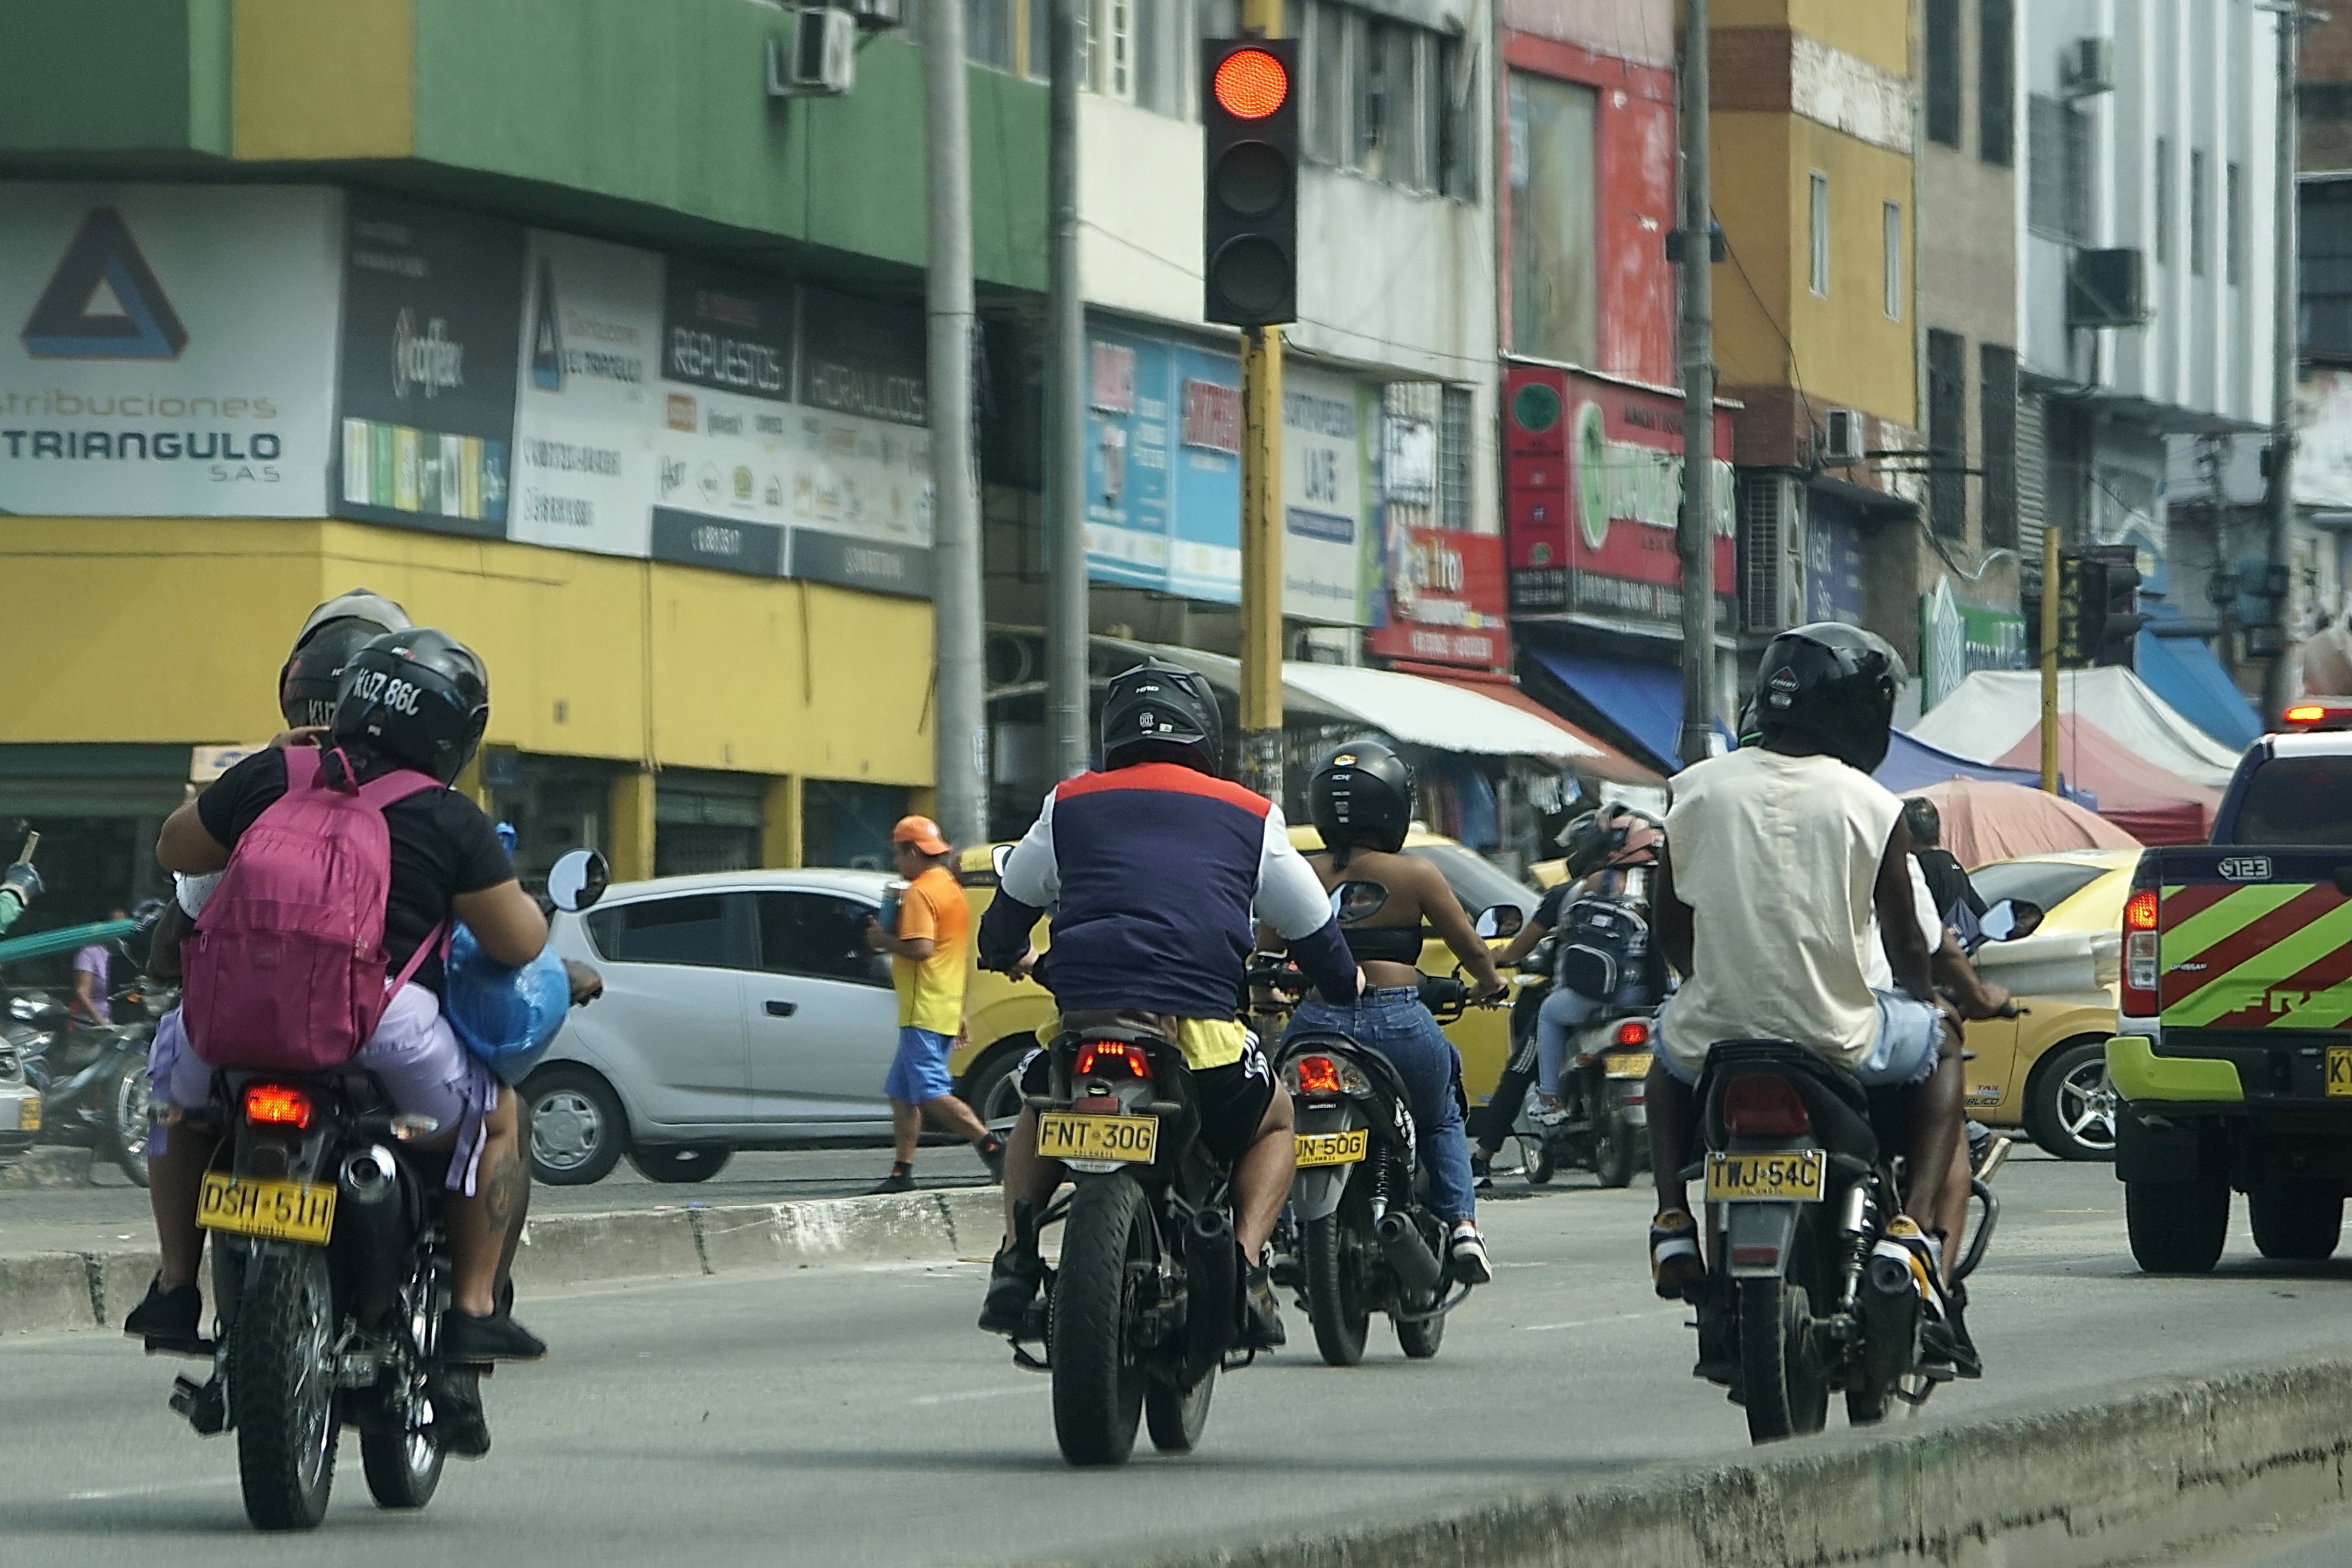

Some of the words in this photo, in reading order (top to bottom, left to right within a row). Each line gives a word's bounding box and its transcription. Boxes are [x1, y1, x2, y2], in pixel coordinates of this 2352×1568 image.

[675, 328, 781, 390] REPUESTOS
[2, 430, 281, 460] TRIANGULO
[353, 667, 388, 703] KUZ
[384, 678, 422, 716] 86C
[2235, 859, 2269, 877] 123
[1041, 1121, 1091, 1147] FNT
[1103, 1124, 1151, 1150] 30G
[1323, 1136, 1361, 1155] 50G
[1713, 1160, 1758, 1188] TWJ
[1769, 1159, 1818, 1188] 54C
[203, 1183, 260, 1220] DSH
[275, 1191, 329, 1228] 51H
